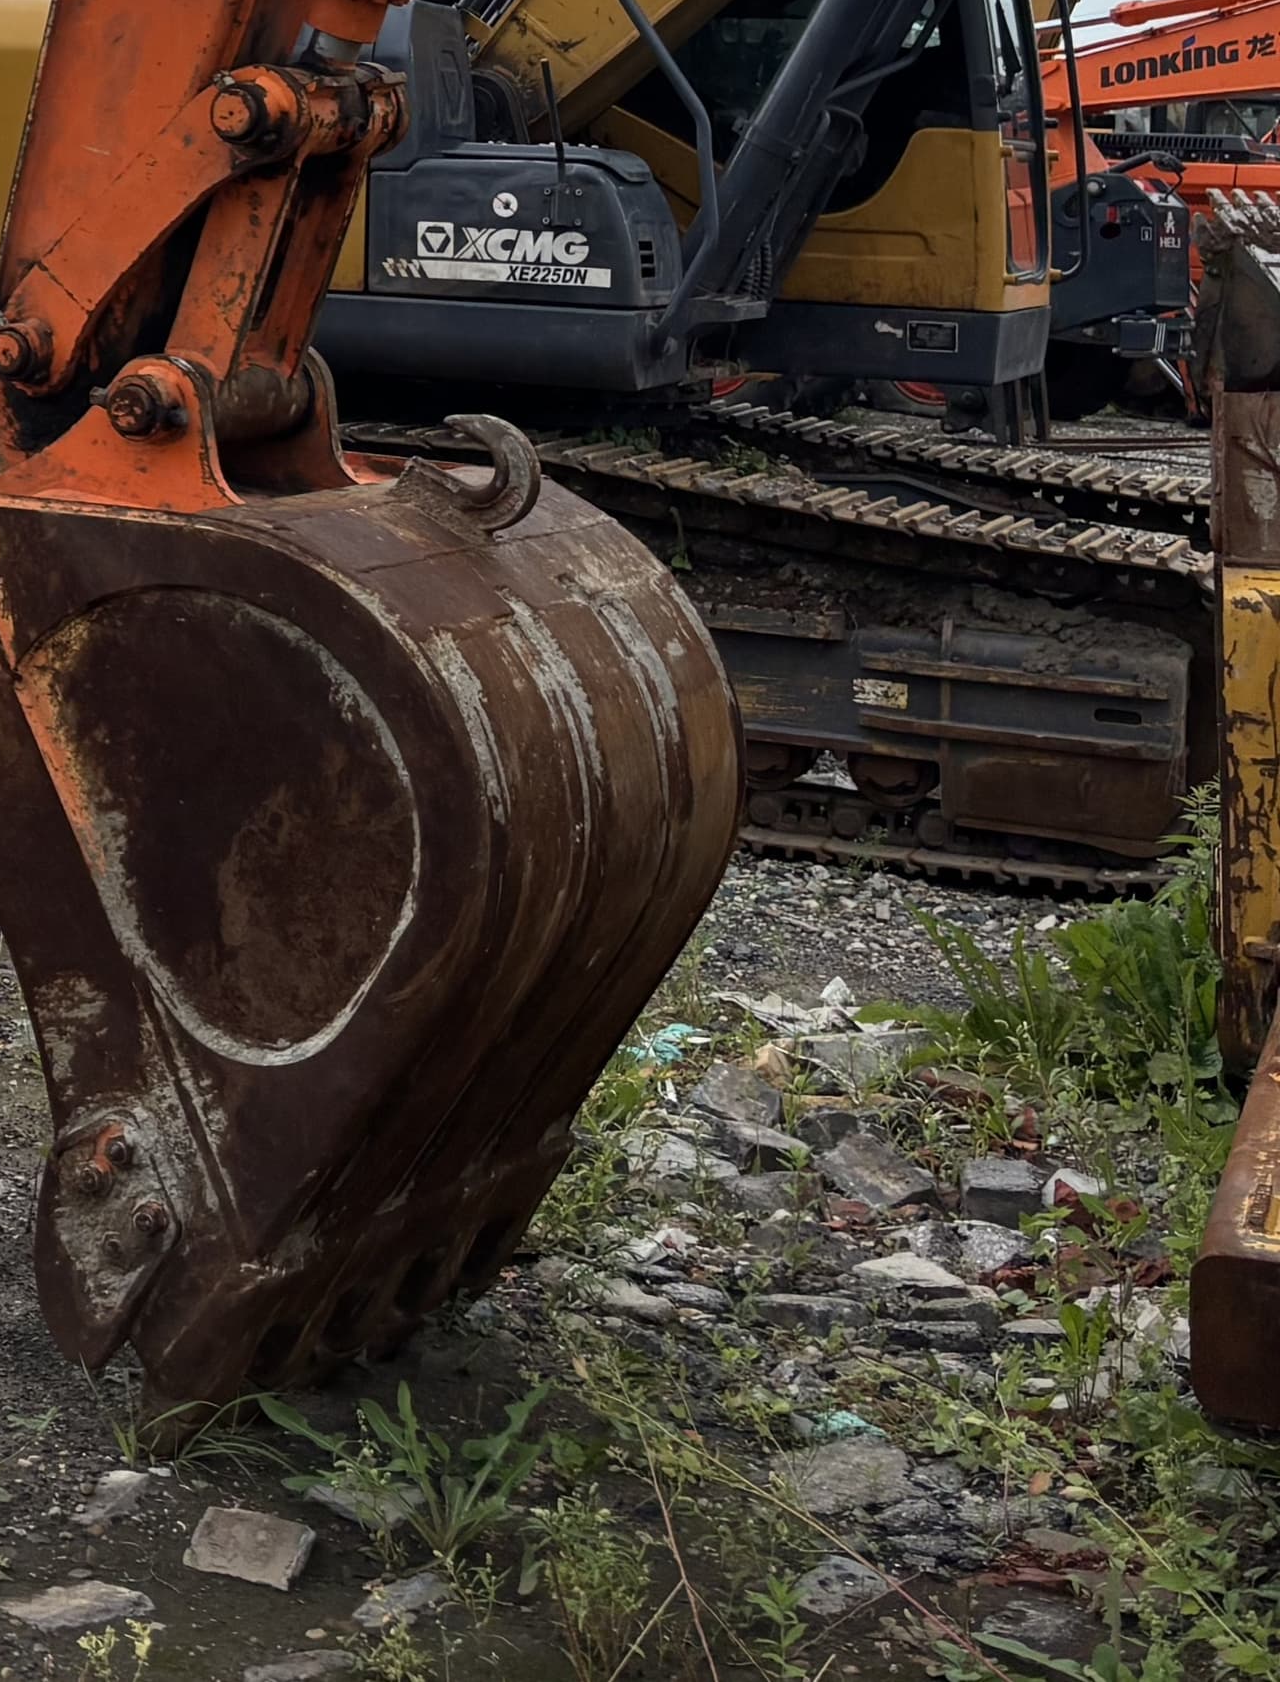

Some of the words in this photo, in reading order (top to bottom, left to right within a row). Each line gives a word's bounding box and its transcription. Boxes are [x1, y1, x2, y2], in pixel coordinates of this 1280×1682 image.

[1245, 32, 1280, 60] 龙
[454, 226, 590, 265] XCMG
[506, 265, 588, 285] XE225DN
